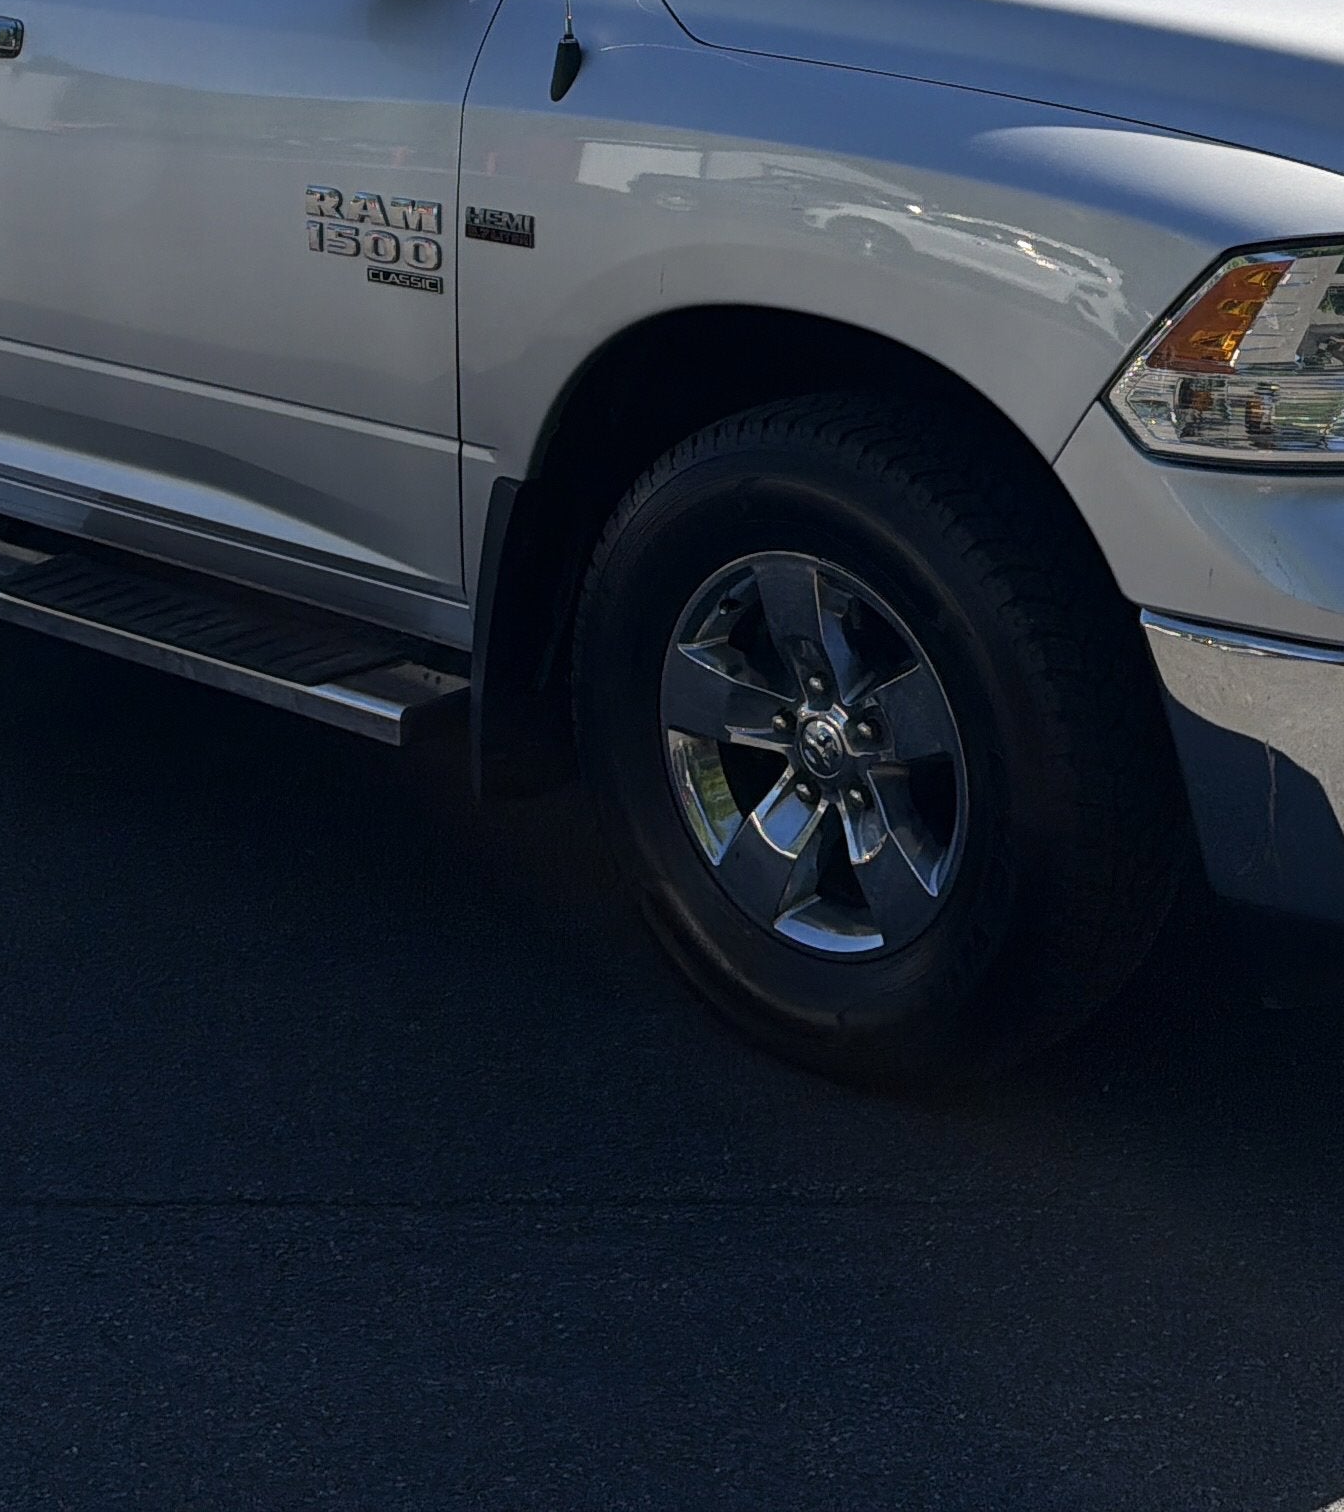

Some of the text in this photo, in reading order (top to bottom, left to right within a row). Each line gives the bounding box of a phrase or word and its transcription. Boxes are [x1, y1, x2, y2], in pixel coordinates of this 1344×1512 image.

[305, 184, 442, 234] RAM
[465, 206, 535, 234] HEMI
[306, 220, 443, 271] 1500
[368, 269, 439, 291] CLASSIC
